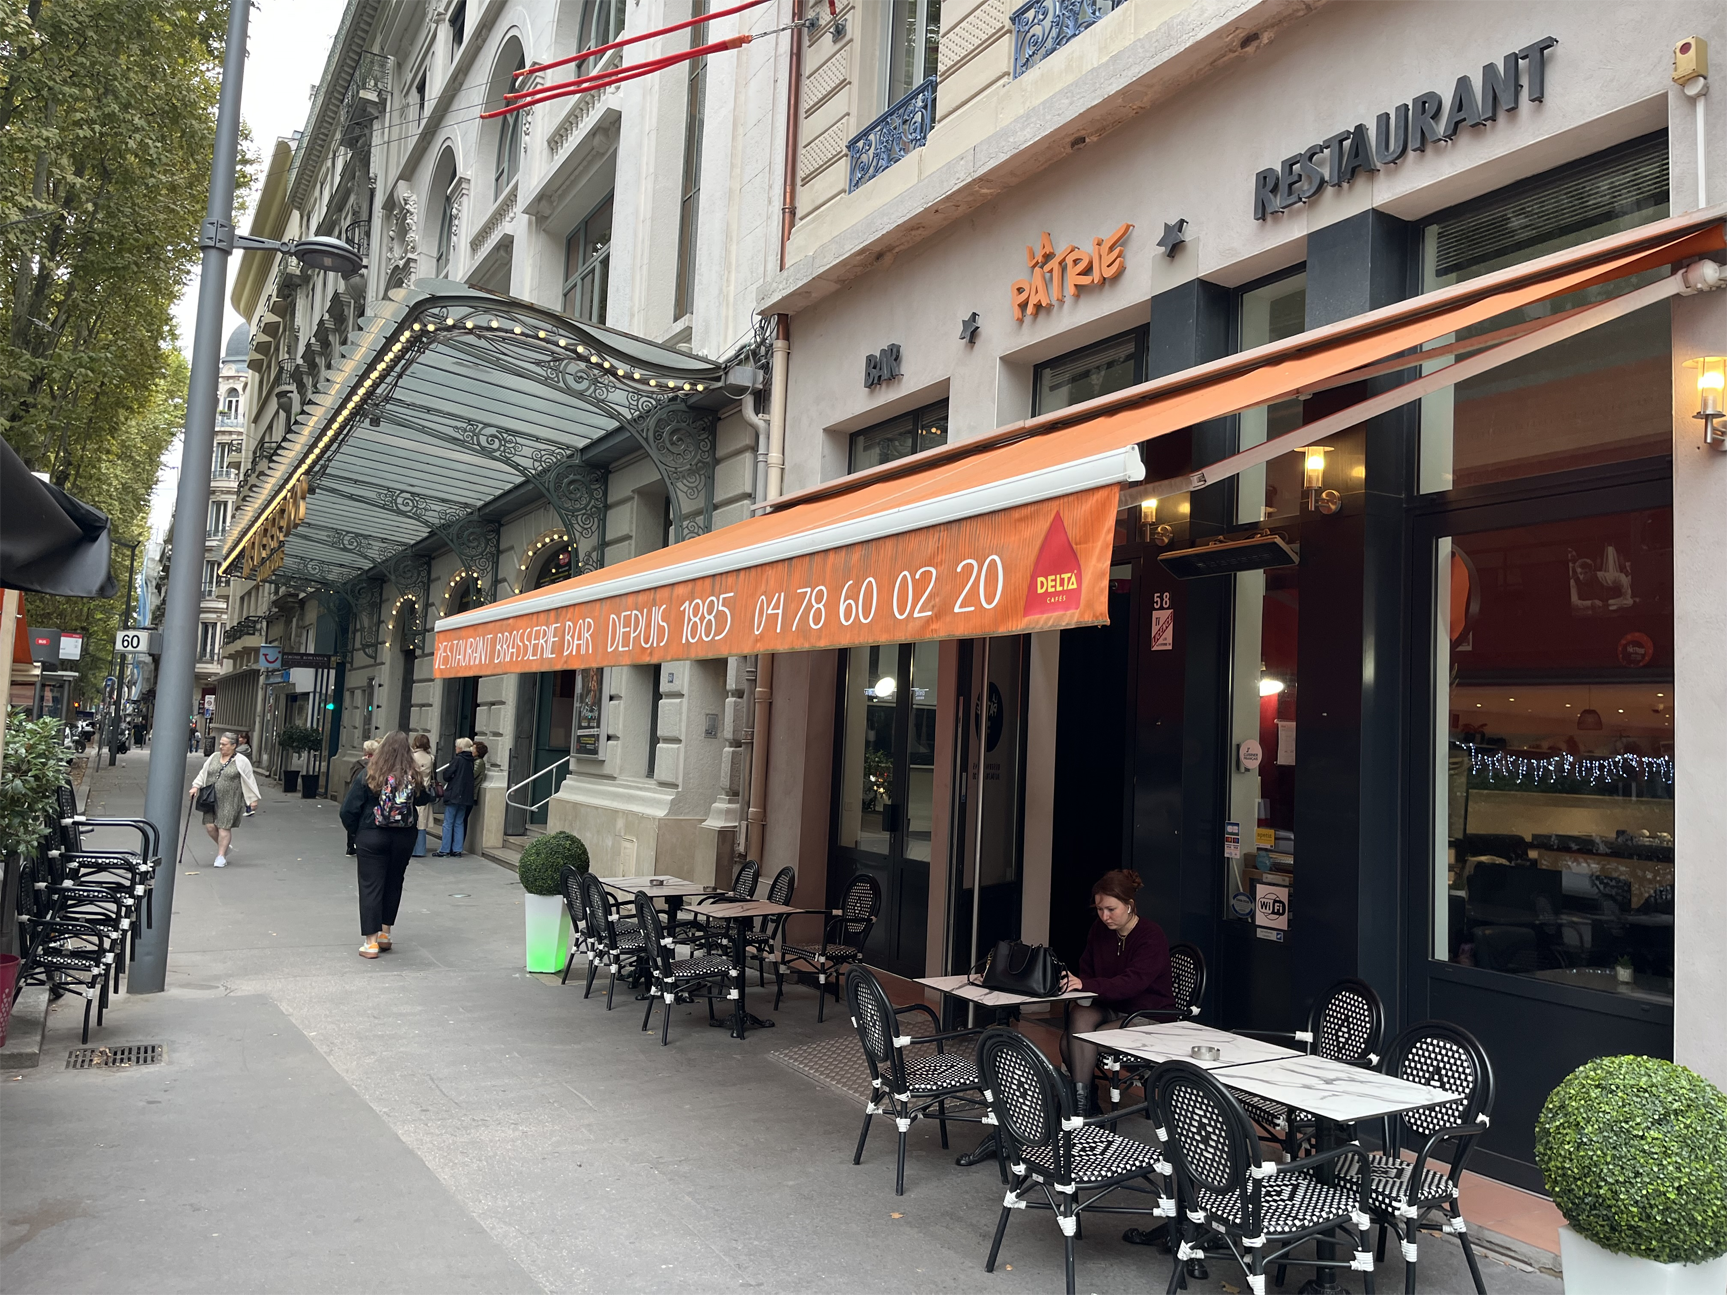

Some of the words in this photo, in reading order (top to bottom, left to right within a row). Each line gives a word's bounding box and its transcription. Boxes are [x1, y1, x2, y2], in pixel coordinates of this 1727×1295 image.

[1253, 35, 1556, 221] RESTAURANT
[1026, 231, 1055, 268] LA
[1011, 223, 1134, 321] PATRIE
[864, 343, 902, 389] BAR
[1037, 572, 1077, 593] DELTA
[1153, 592, 1170, 609] 58
[494, 623, 560, 663] BRASSERIE
[563, 618, 594, 656] BAR
[607, 604, 668, 652] DEPUIS
[680, 592, 734, 643] 1885
[754, 592, 784, 634] 04
[792, 586, 827, 631] 78
[839, 577, 877, 626] 60
[893, 566, 936, 619] 02
[953, 554, 1003, 613] 20
[121, 634, 140, 649] 60
